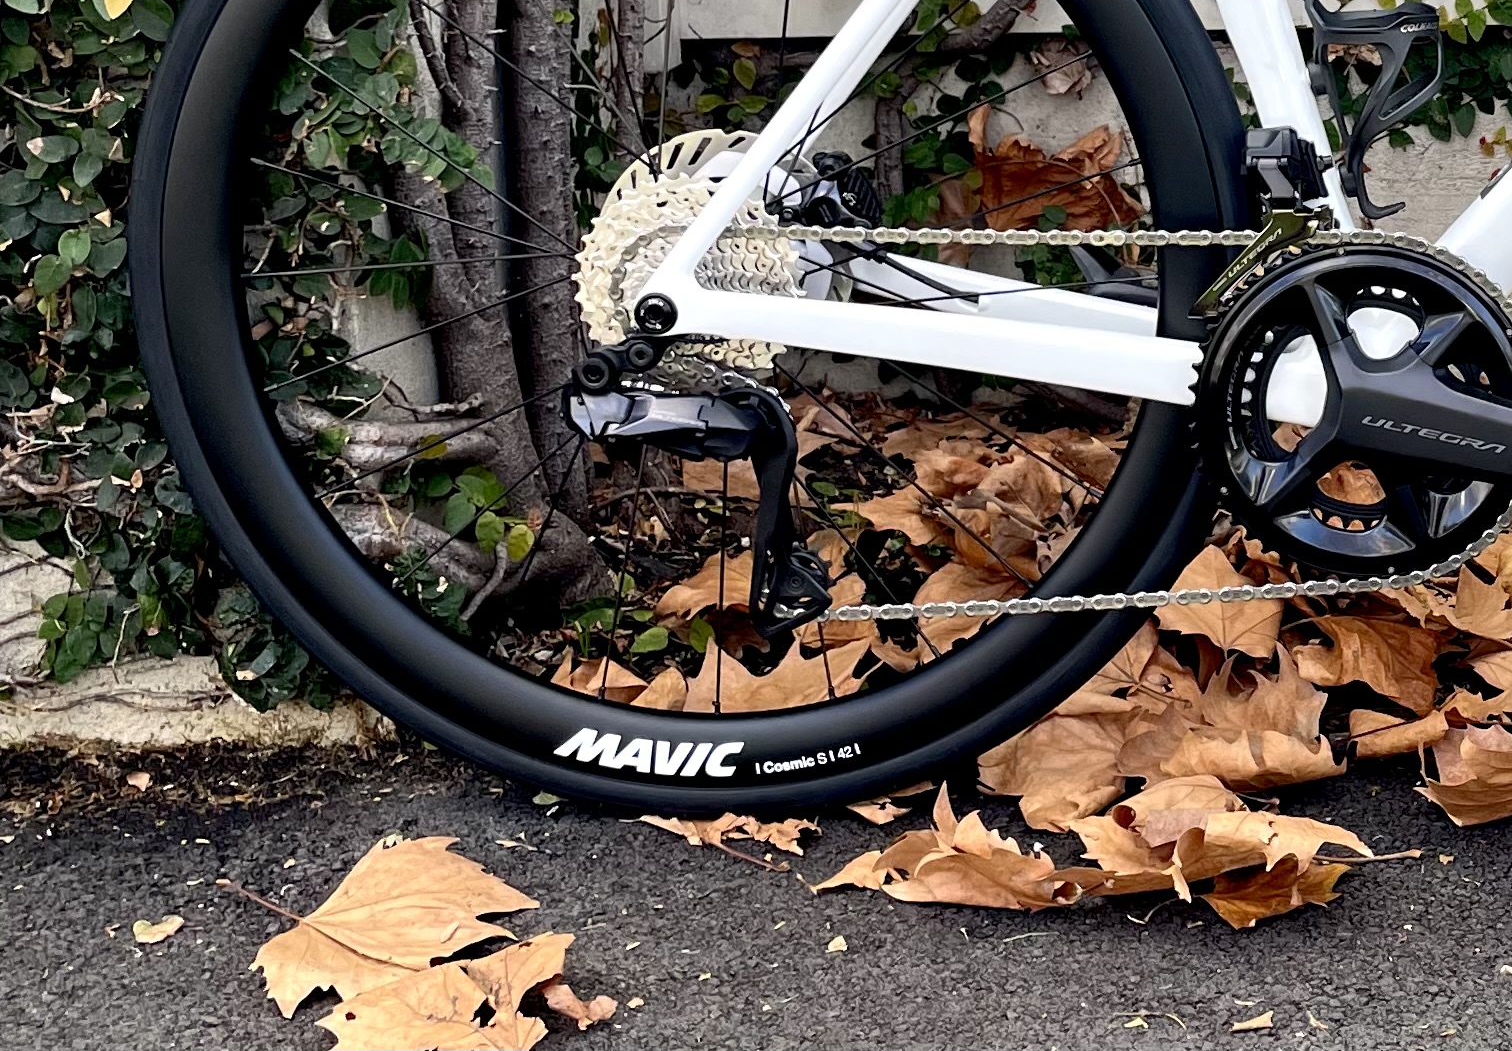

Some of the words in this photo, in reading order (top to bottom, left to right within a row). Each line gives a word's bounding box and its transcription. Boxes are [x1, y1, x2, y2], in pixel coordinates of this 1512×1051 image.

[1228, 228, 1282, 278] ULTEGRA
[1361, 416, 1507, 454] ULTEGRA
[553, 727, 745, 778] MAVIC
[763, 755, 816, 774] Cosmic
[816, 751, 828, 765] S
[837, 745, 854, 760] 42
